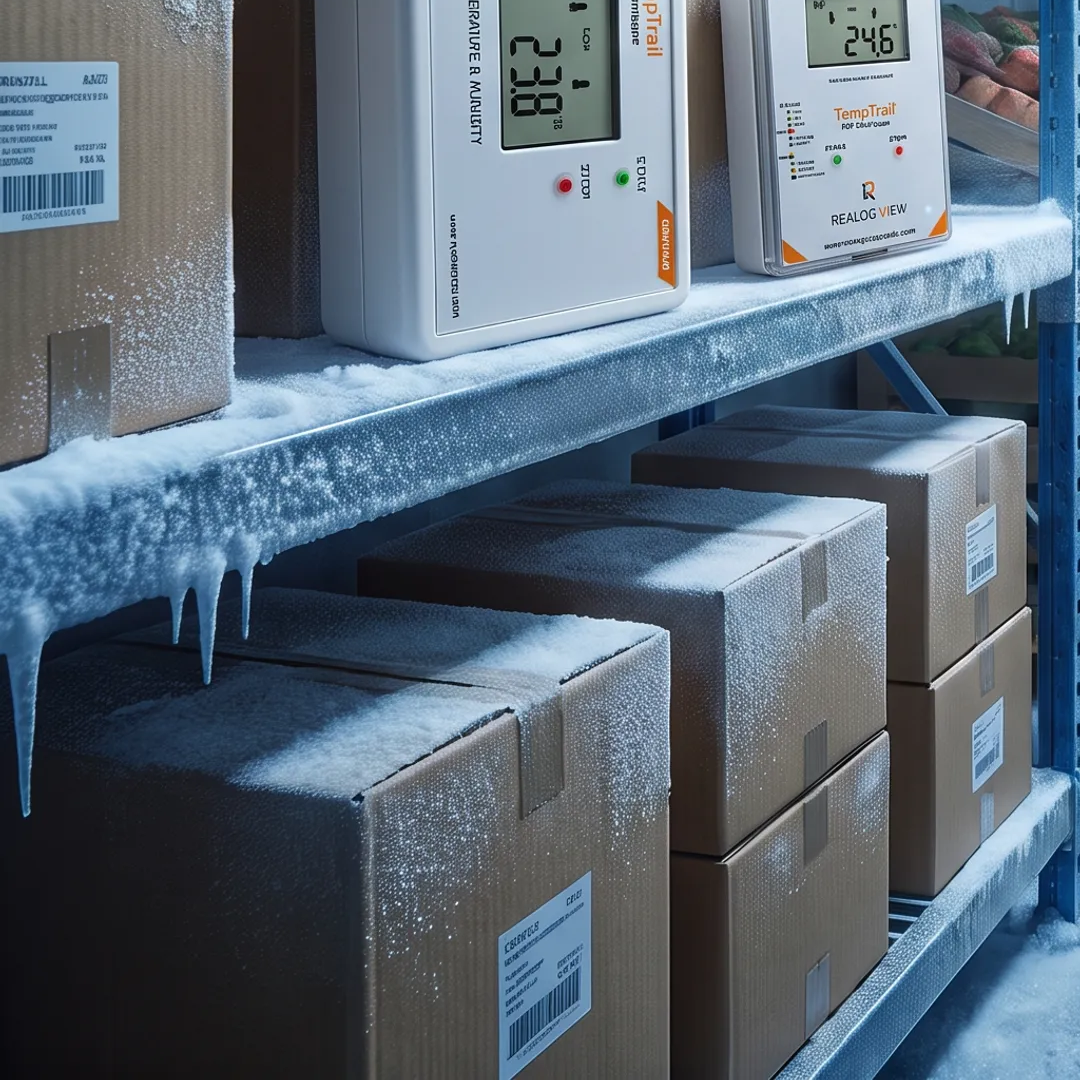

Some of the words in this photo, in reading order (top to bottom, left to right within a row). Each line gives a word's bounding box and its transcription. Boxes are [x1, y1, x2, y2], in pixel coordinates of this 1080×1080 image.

[833, 101, 897, 122] TempTrail
[831, 207, 877, 227] REALOG
[878, 203, 908, 219] VIEW
